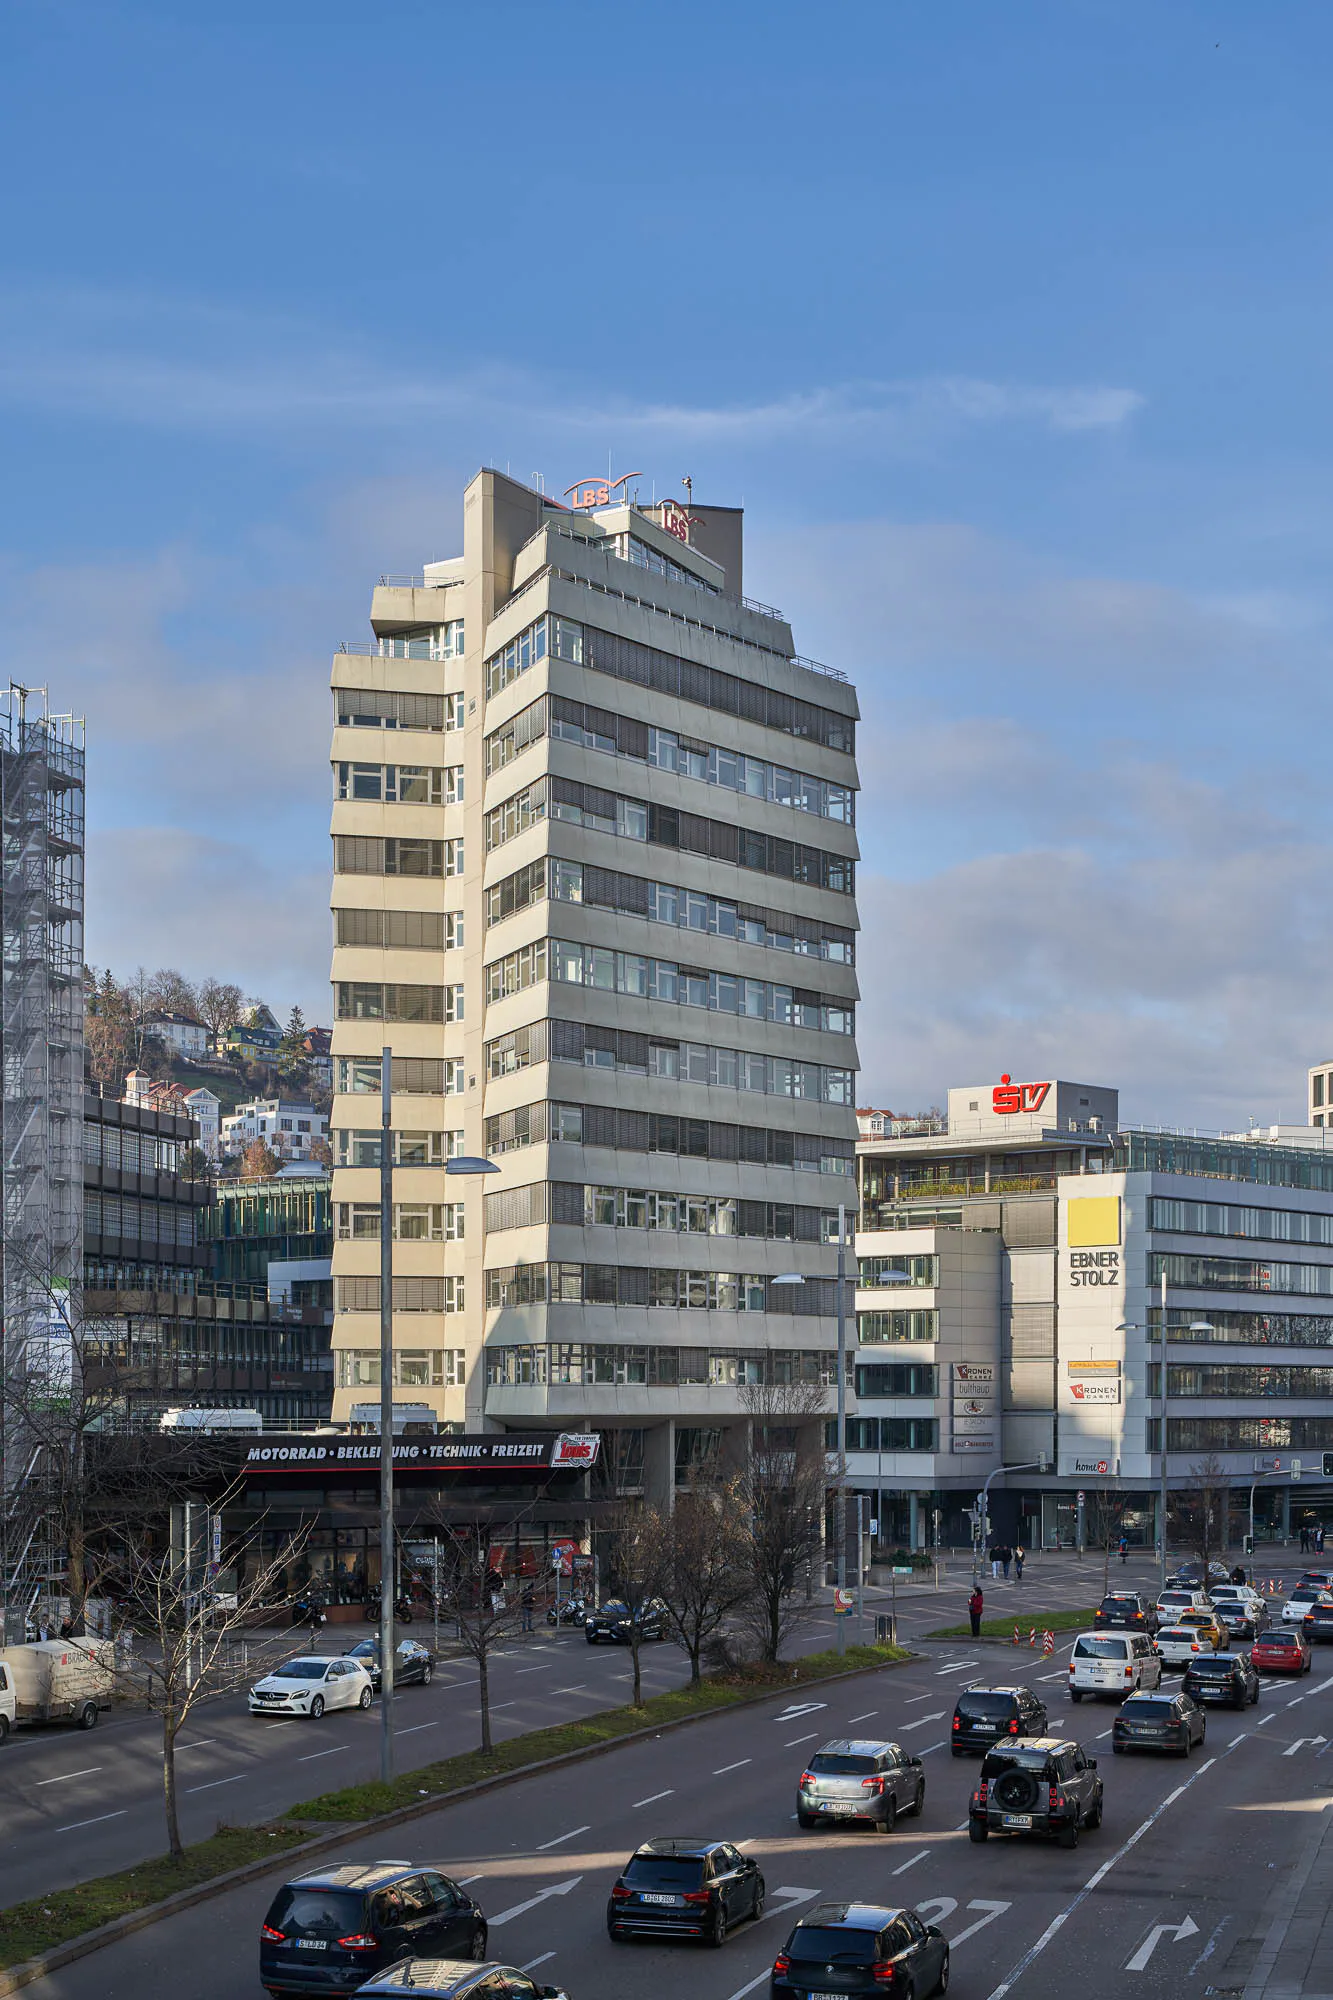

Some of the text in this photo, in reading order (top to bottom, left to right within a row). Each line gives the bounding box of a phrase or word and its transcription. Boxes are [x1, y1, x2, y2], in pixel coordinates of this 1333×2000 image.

[572, 487, 609, 509] LBS
[663, 508, 687, 541] LBS
[1070, 1251, 1119, 1268] EBNER
[1070, 1270, 1119, 1287] STOLZ
[962, 1366, 992, 1375] KRONEN
[959, 1383, 990, 1394] bulthaup
[1076, 1386, 1116, 1394] KRONEN
[247, 1444, 544, 1461] MOTORRAD BEKLEIUNG TECHNIK FREIZEIT
[560, 1442, 592, 1458] Louis
